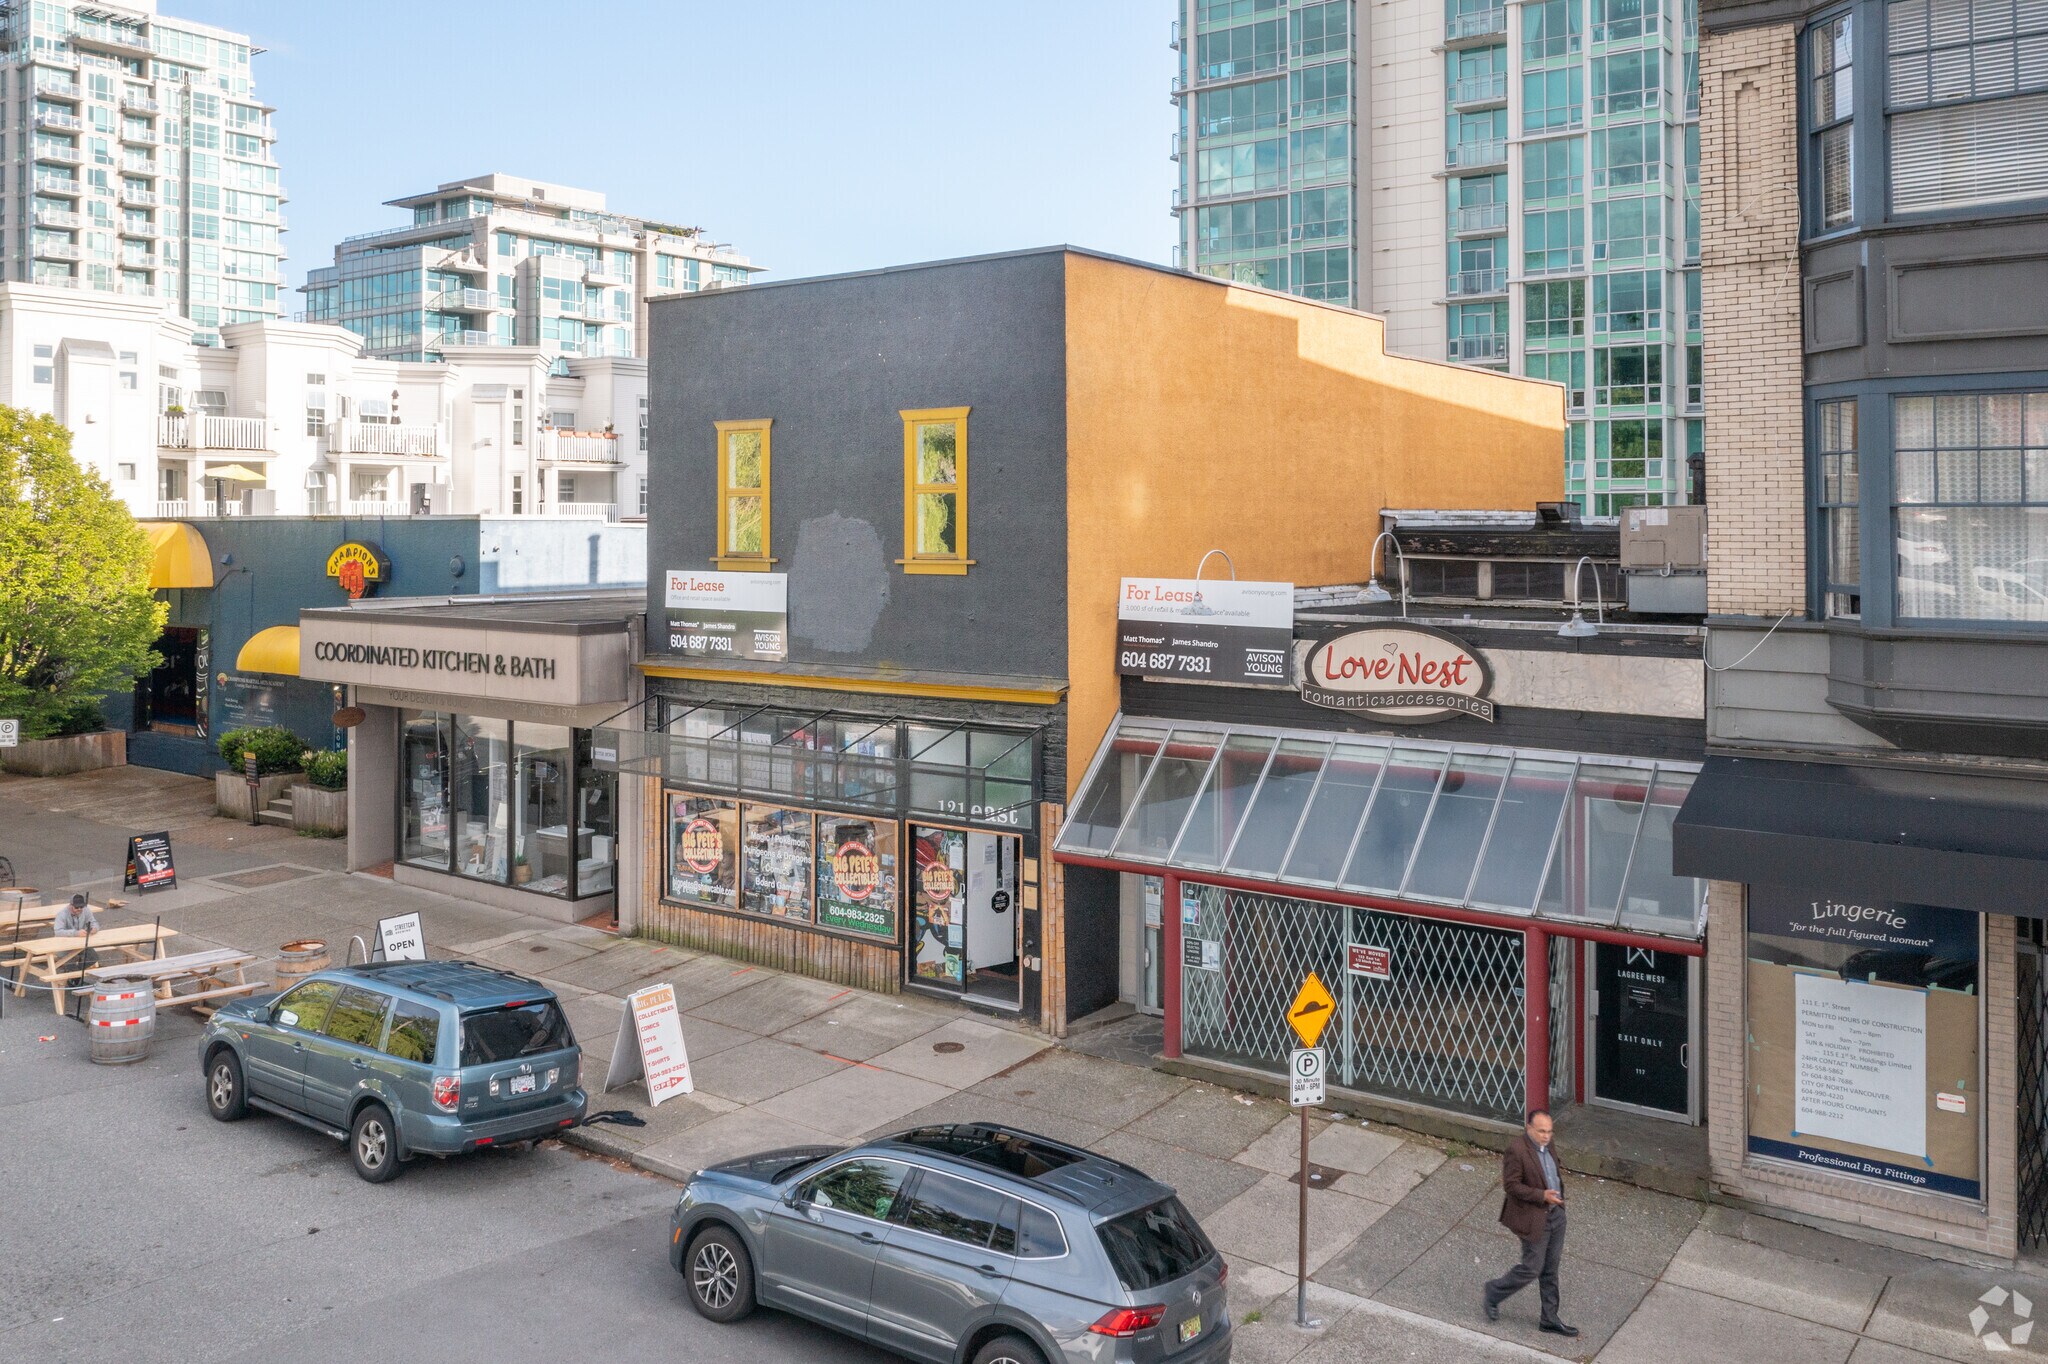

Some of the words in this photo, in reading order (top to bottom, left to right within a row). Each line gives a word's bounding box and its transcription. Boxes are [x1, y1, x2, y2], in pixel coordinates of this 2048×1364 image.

[330, 548, 375, 575] CHAMPIONS
[671, 577, 687, 590] For
[690, 578, 725, 592] Lease
[1126, 584, 1150, 600] For
[1242, 589, 1287, 597] avisonyoung.com
[1224, 609, 1250, 617] available
[670, 634, 688, 648] 604
[689, 636, 708, 649] 687
[710, 637, 733, 651] 7331
[754, 633, 780, 642] AVISON
[1172, 638, 1192, 646] James
[1192, 640, 1219, 648] Shandro
[754, 642, 780, 650] YOUNG
[315, 641, 419, 668] COORDINATED
[423, 649, 490, 674] KITCHEN
[494, 654, 506, 676] &
[510, 656, 556, 679] BATH
[1121, 651, 1146, 668] 604
[1150, 652, 1176, 670] 687
[1178, 655, 1212, 673] 7331
[1246, 653, 1283, 664] AVISON
[1246, 664, 1283, 674] YOUNG
[1325, 645, 1395, 680] Love
[1398, 652, 1472, 688] Nest
[388, 690, 408, 702] YOUR
[1304, 688, 1380, 708] romantic
[1386, 694, 1490, 716] accessories
[557, 707, 578, 720] 1974
[682, 832, 697, 849] BIG
[697, 832, 723, 848] PETE'S
[684, 847, 724, 862] COLLECTIBLES
[744, 846, 776, 858] Dungeons
[776, 851, 782, 859] &
[784, 852, 812, 864] Dragons
[833, 855, 849, 872] BIG
[849, 855, 879, 872] PETE'S
[756, 876, 776, 888] Board
[834, 872, 880, 886] COLLECTIBLES
[922, 870, 934, 882] BIG
[935, 870, 954, 883] PETE'S
[922, 880, 955, 892] COLLECTIBLES
[825, 914, 847, 925] Every
[1811, 900, 1906, 929] Lingerie
[1808, 925, 1825, 934] the
[1826, 926, 1846, 936] full
[1847, 929, 1886, 941] figured
[389, 939, 415, 952] OPEN
[1618, 970, 1644, 980] LAGREE
[1646, 974, 1665, 984] WEST
[636, 999, 648, 1009] BIG
[650, 992, 672, 1005] PETE'S
[638, 1004, 674, 1020] COLLECTIBLES
[1832, 1004, 1850, 1012] Street
[640, 1022, 660, 1032] COMICS
[1802, 1010, 1836, 1020] PERMITTED
[1838, 1016, 1860, 1024] HOURS
[1872, 1020, 1922, 1034] CONSTRUCTION
[643, 1035, 656, 1044] TOYS
[1618, 1034, 1638, 1044] EXIT
[1640, 1038, 1662, 1048] ONLY
[645, 1046, 664, 1056] GAMES
[1824, 1042, 1850, 1051] HOLIDAY
[1858, 1048, 1895, 1058] PROHIBITED
[648, 1056, 670, 1068] T-SHIRTS
[1304, 1058, 1314, 1072] P
[1818, 1058, 1848, 1067] CONTACT
[1860, 1056, 1887, 1066] Holdings
[1888, 1061, 1912, 1070] Limited
[654, 1078, 678, 1092] OPEN
[1826, 1084, 1848, 1092] NORTH
[1802, 1096, 1820, 1104] AFTER
[1822, 1100, 1844, 1108] HOURS
[1846, 1104, 1886, 1116] COMPLAINTS
[1798, 1150, 1861, 1170] Professional
[1862, 1164, 1882, 1175] Bra
[1884, 1168, 1926, 1184] Fittings
